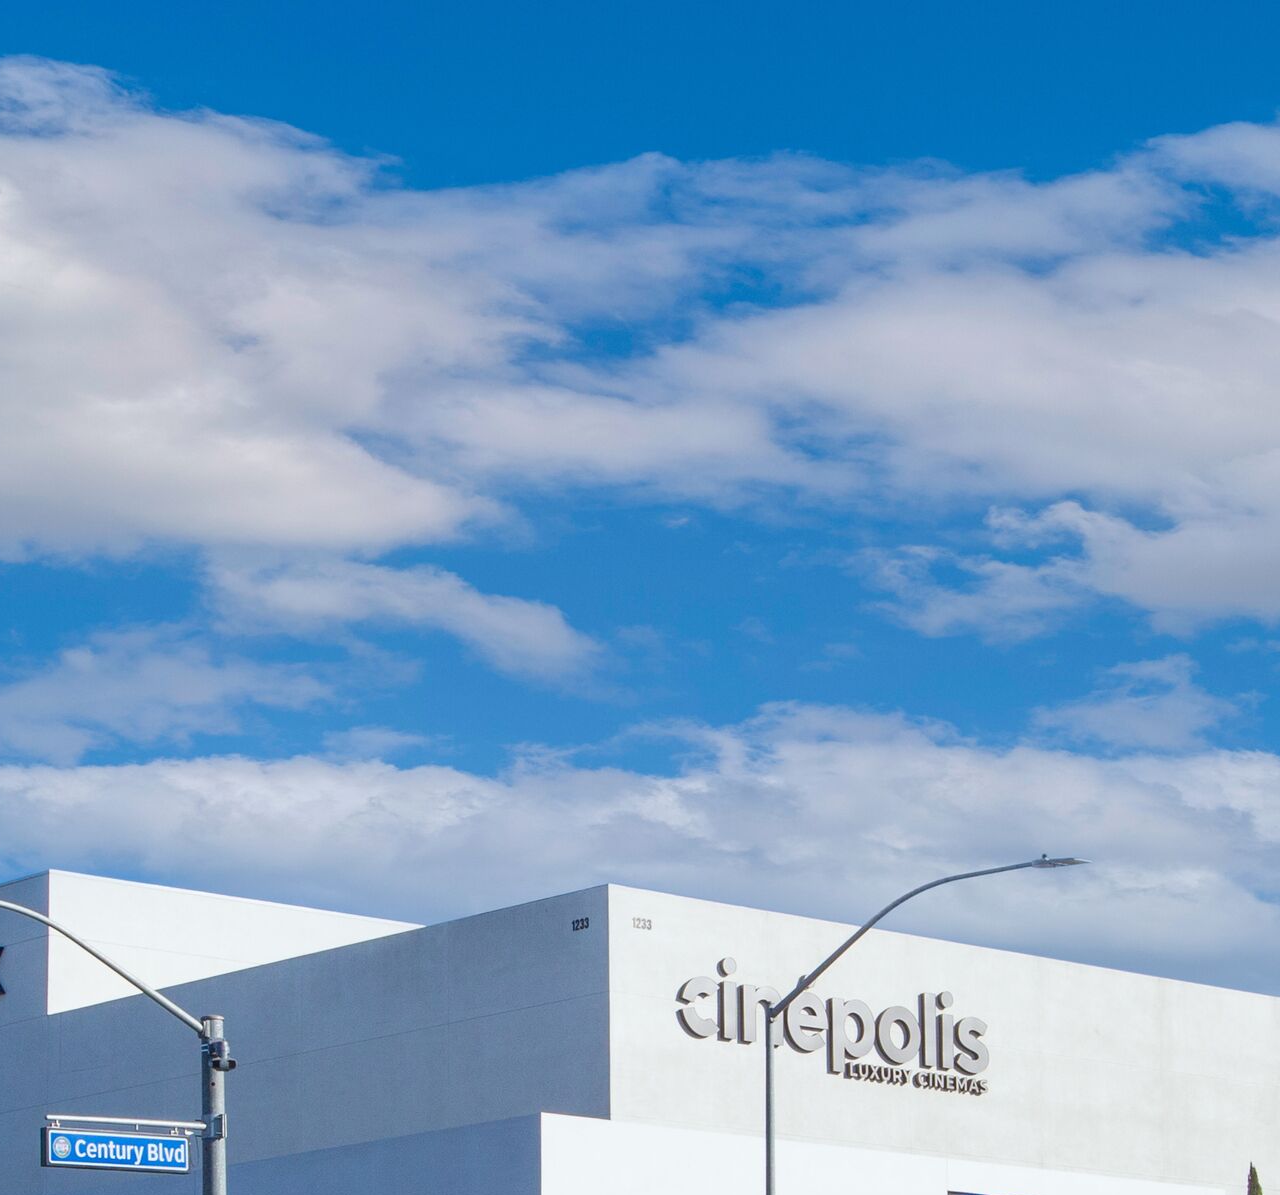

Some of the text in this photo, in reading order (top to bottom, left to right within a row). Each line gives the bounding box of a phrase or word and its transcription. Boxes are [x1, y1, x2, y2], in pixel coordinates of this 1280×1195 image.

[571, 917, 590, 931] 1233
[632, 917, 652, 930] 1233
[675, 956, 990, 1076] cinépolis
[844, 1061, 989, 1096] LUXURY CINEMAS
[74, 1138, 185, 1166] Century Blvd
